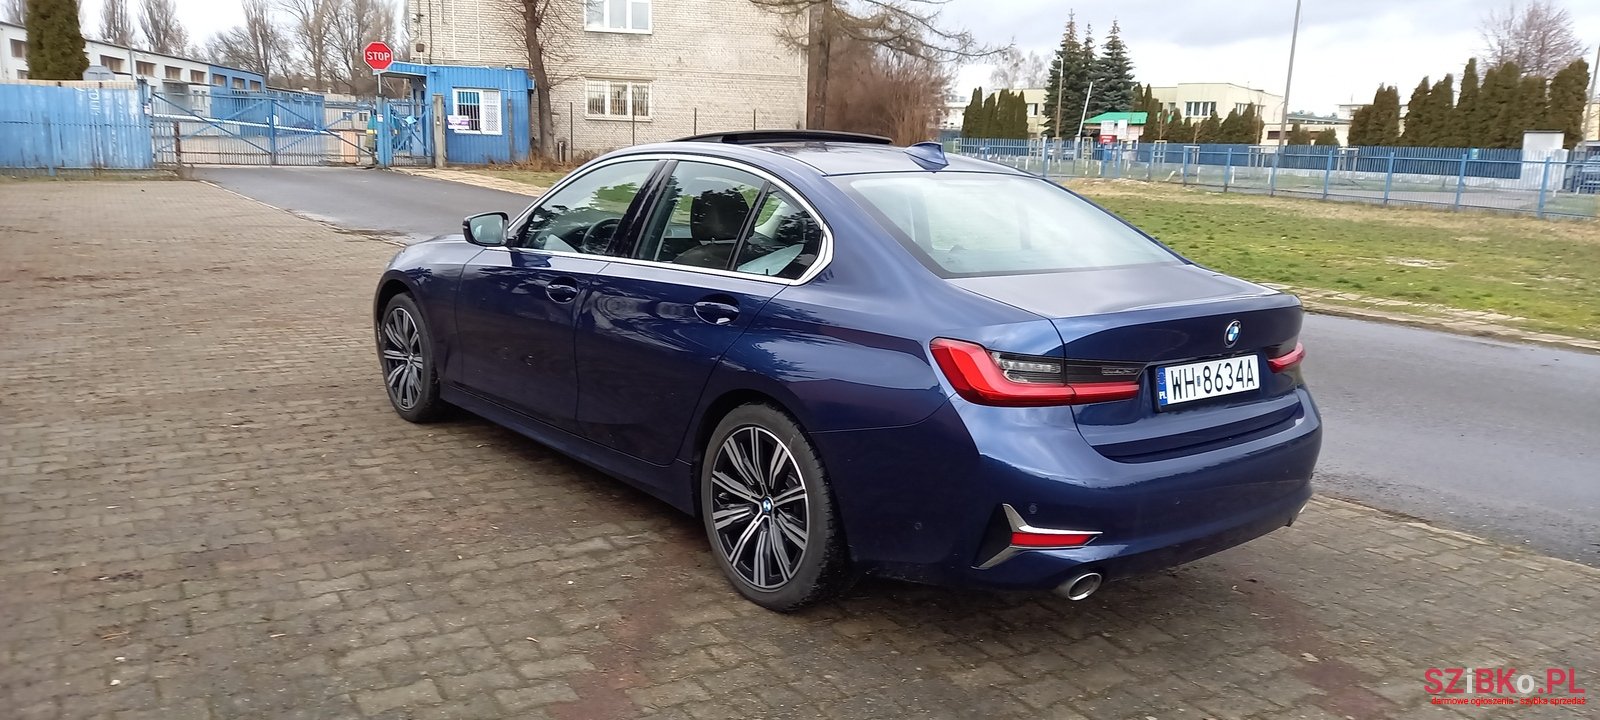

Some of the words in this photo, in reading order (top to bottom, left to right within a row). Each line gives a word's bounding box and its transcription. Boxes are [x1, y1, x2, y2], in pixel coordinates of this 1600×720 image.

[366, 51, 390, 61] STOP
[1170, 367, 1196, 400] WH
[1203, 359, 1255, 394] 8634A
[1158, 391, 1168, 400] PL
